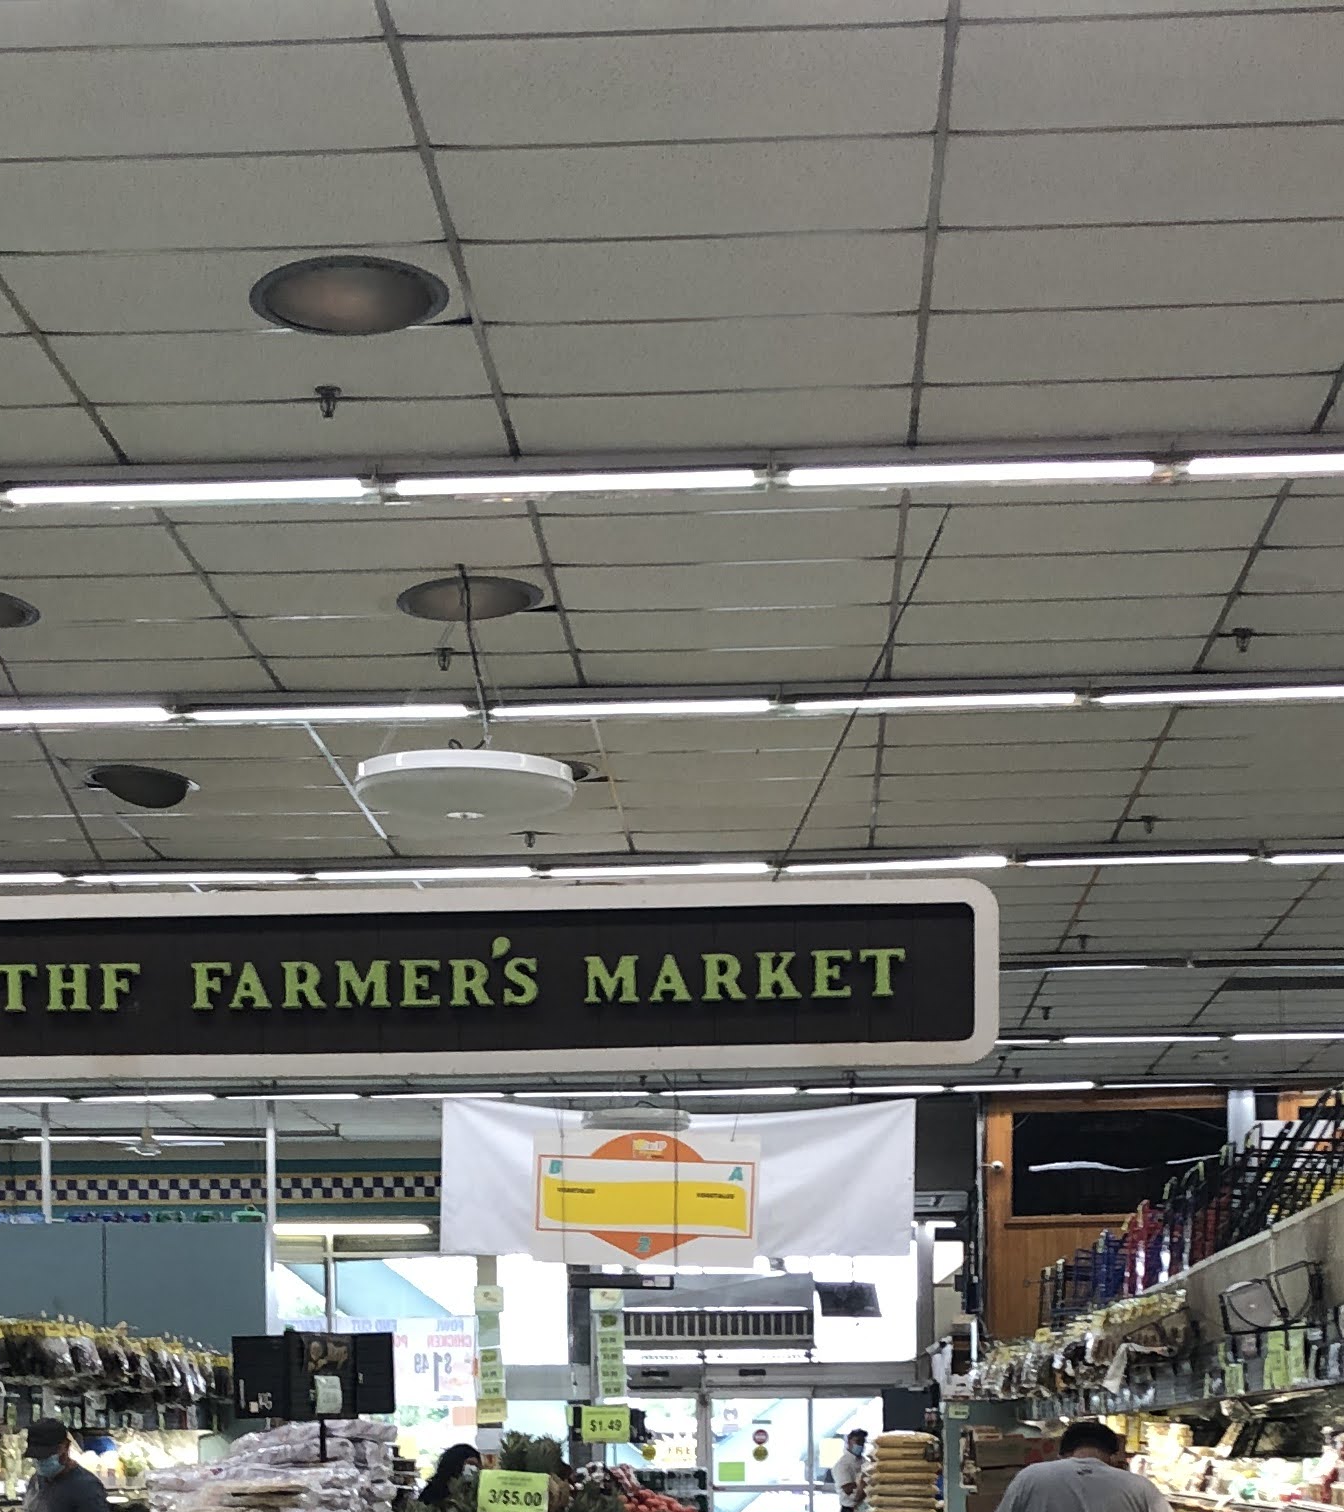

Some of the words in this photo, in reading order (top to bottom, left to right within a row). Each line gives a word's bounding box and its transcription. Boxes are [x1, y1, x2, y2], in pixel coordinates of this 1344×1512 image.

[190, 935, 539, 1011] FARMER'S
[583, 947, 906, 1004] MARKET
[728, 1166, 744, 1182] A
[589, 1418, 623, 1434] $1.49
[487, 1488, 543, 1507] 3/$5.00
